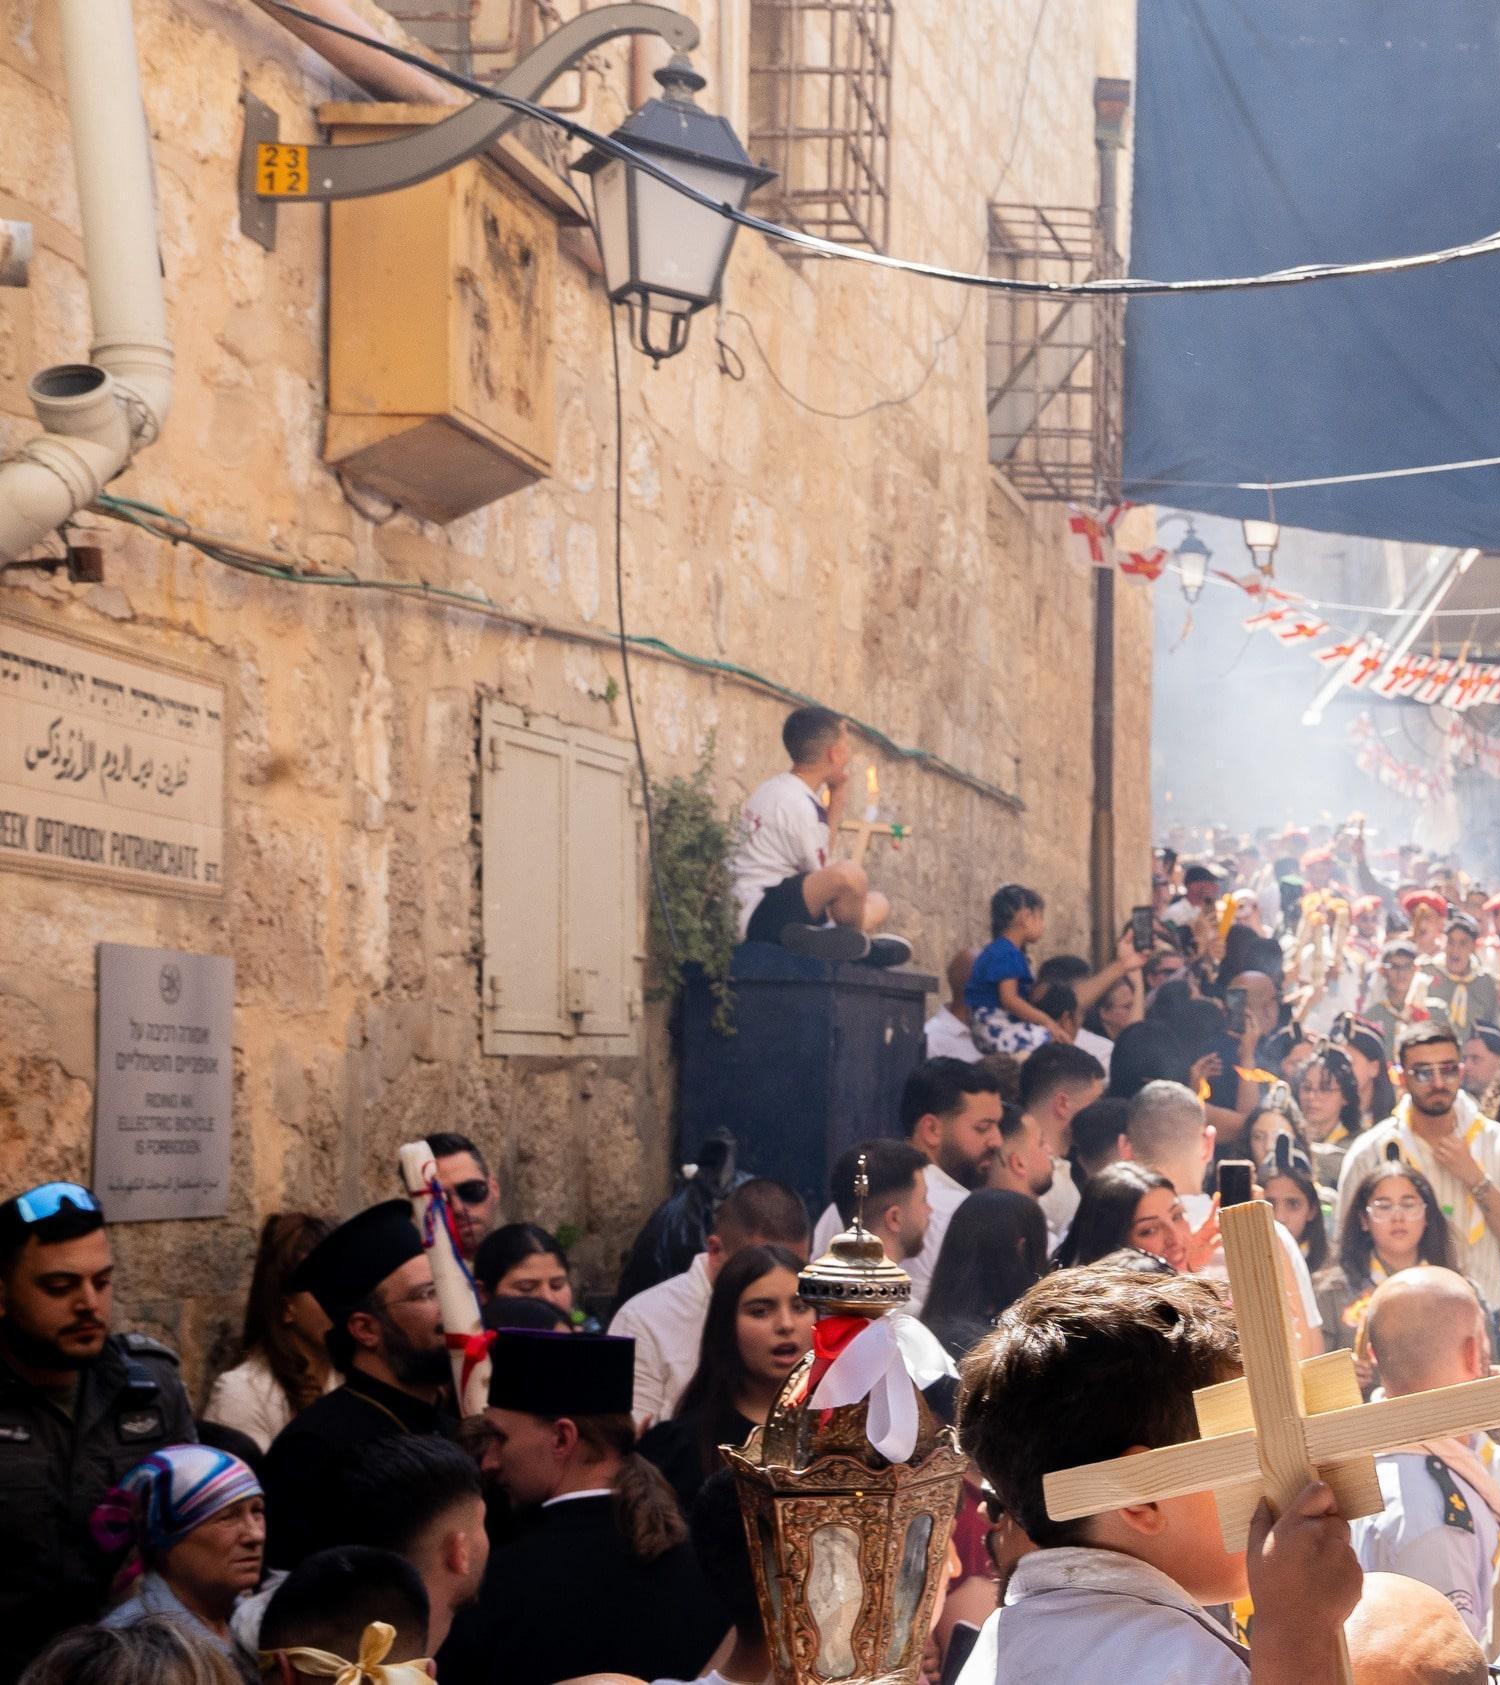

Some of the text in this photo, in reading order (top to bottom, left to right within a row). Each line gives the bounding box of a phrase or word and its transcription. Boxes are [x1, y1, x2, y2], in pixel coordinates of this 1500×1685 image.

[265, 146, 300, 168] 23
[264, 171, 300, 192] 12
[0, 809, 28, 850] EEK
[35, 816, 105, 865] ORTHODOX
[110, 831, 200, 881] PATRIARCHATE
